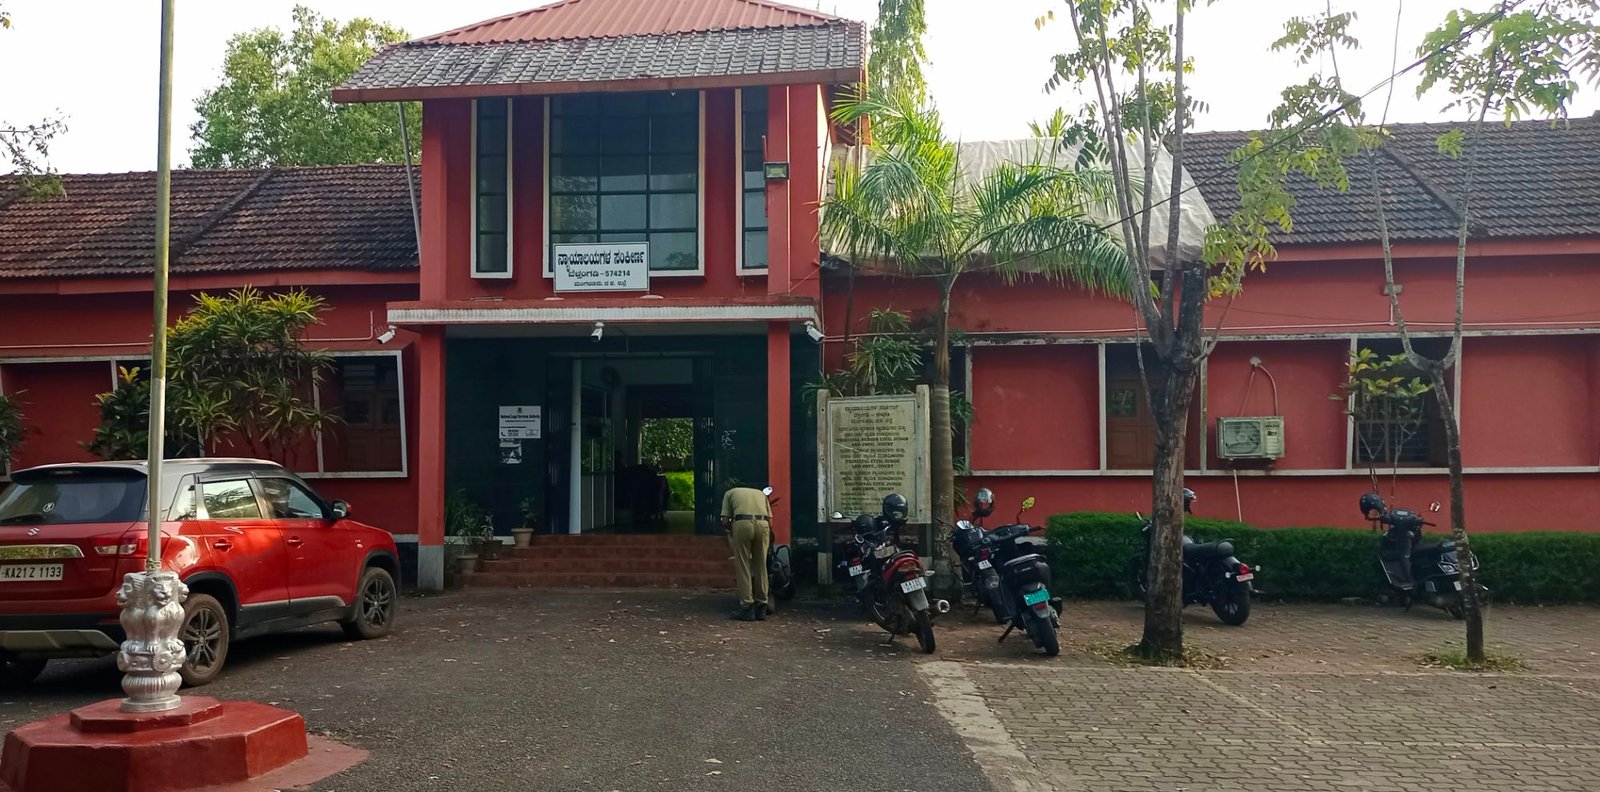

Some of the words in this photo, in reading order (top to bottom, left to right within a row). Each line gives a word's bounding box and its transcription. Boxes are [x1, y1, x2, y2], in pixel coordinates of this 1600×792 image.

[5, 567, 27, 578] KA21
[29, 567, 36, 578] Z
[39, 566, 61, 578] 1133
